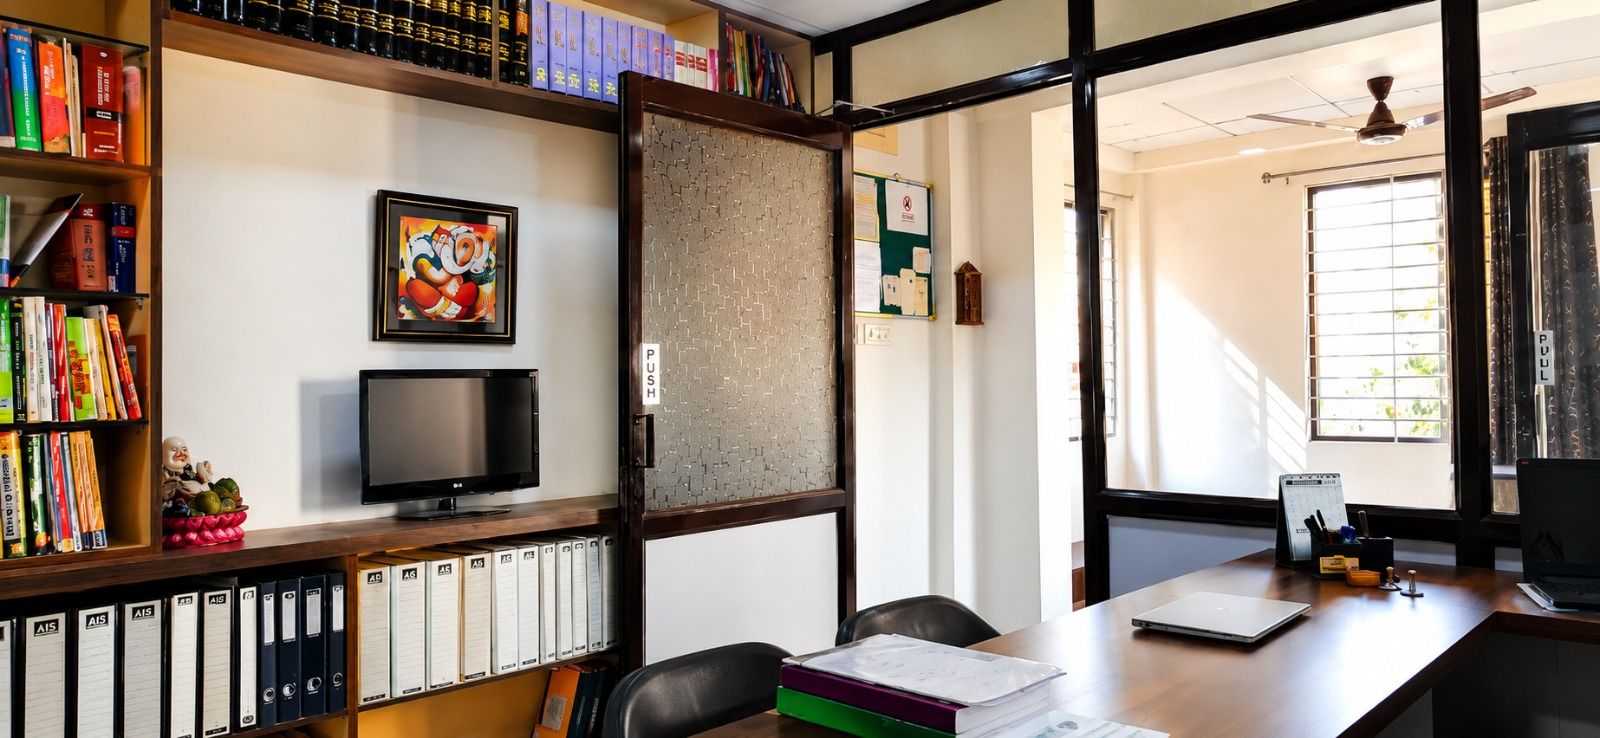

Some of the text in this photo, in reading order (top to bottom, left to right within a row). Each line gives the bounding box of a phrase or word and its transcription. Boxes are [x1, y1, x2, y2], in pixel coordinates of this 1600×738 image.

[646, 349, 656, 398] PUSH
[134, 607, 152, 618] AIS
[88, 615, 106, 626] AIS
[36, 622, 56, 634] AIS
